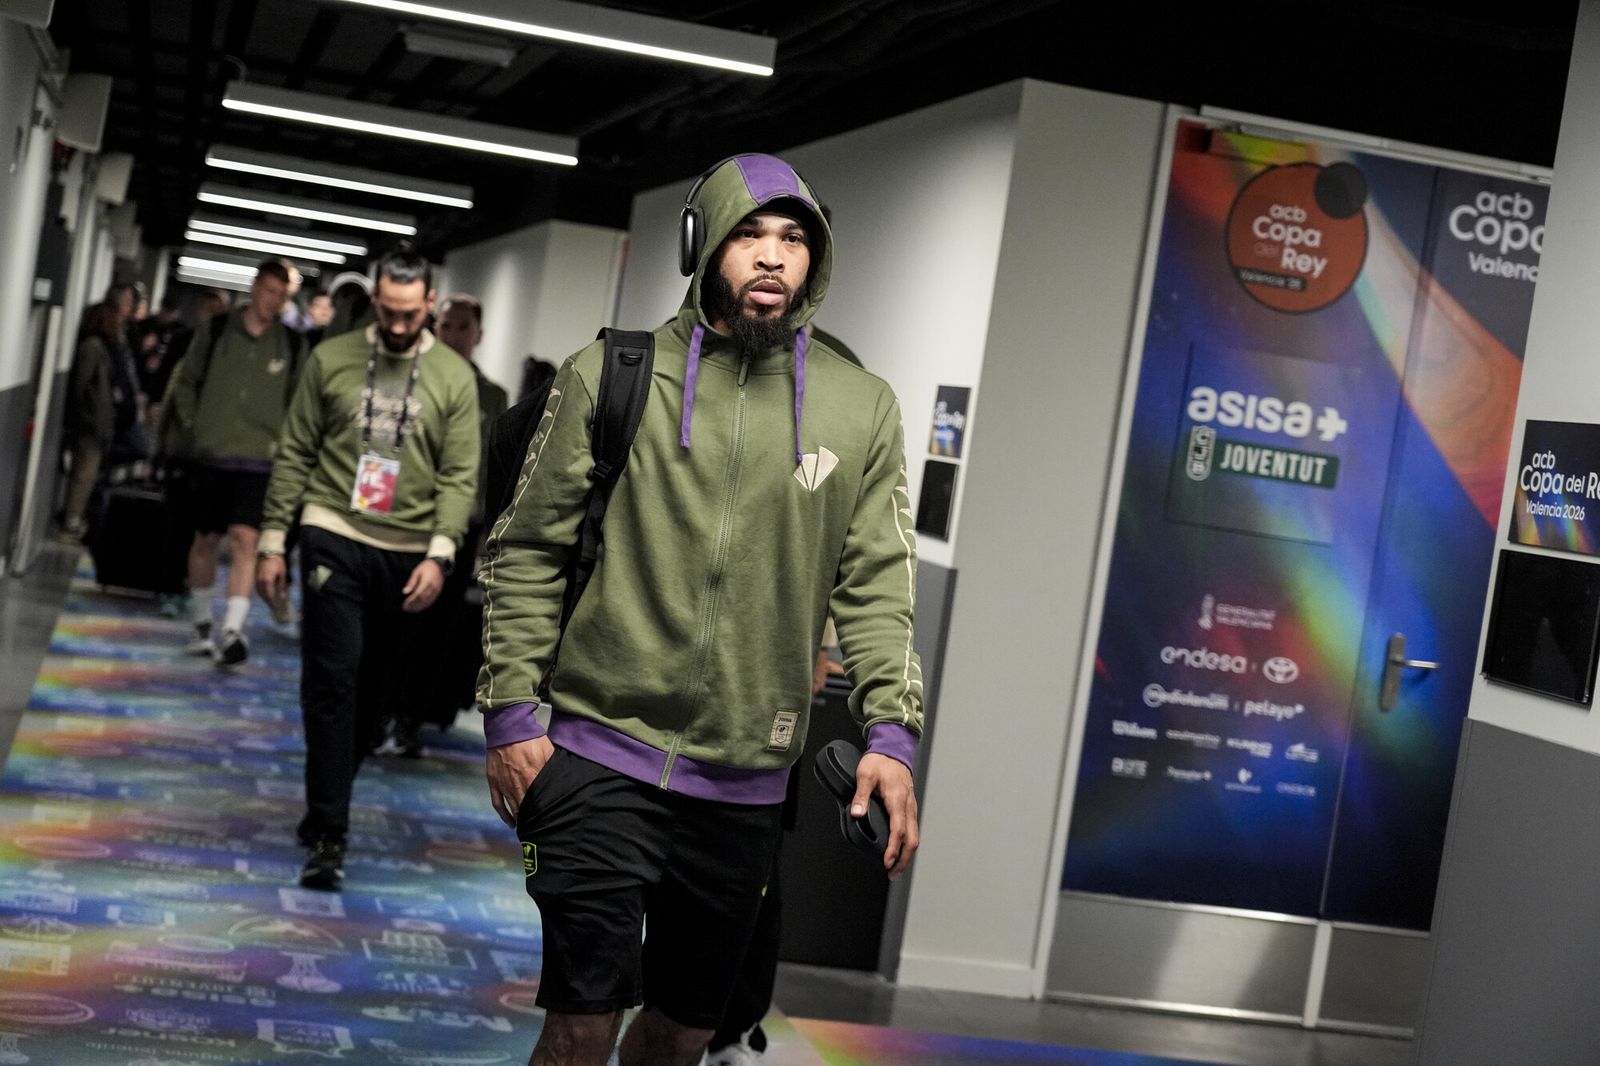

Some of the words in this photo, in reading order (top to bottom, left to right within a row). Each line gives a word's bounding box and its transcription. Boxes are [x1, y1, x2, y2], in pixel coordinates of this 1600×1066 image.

[1269, 204, 1307, 223] acb
[1475, 190, 1534, 221] acb
[1252, 216, 1322, 249] Copa
[1280, 247, 1328, 279] Rey
[1220, 443, 1328, 484] JOVENTUT
[1532, 450, 1555, 470] acb
[1521, 465, 1565, 498] Copa
[1566, 474, 1585, 494] del
[1526, 499, 1562, 518] Valencia
[1562, 504, 1585, 521] 2026
[1160, 646, 1247, 674] endesa
